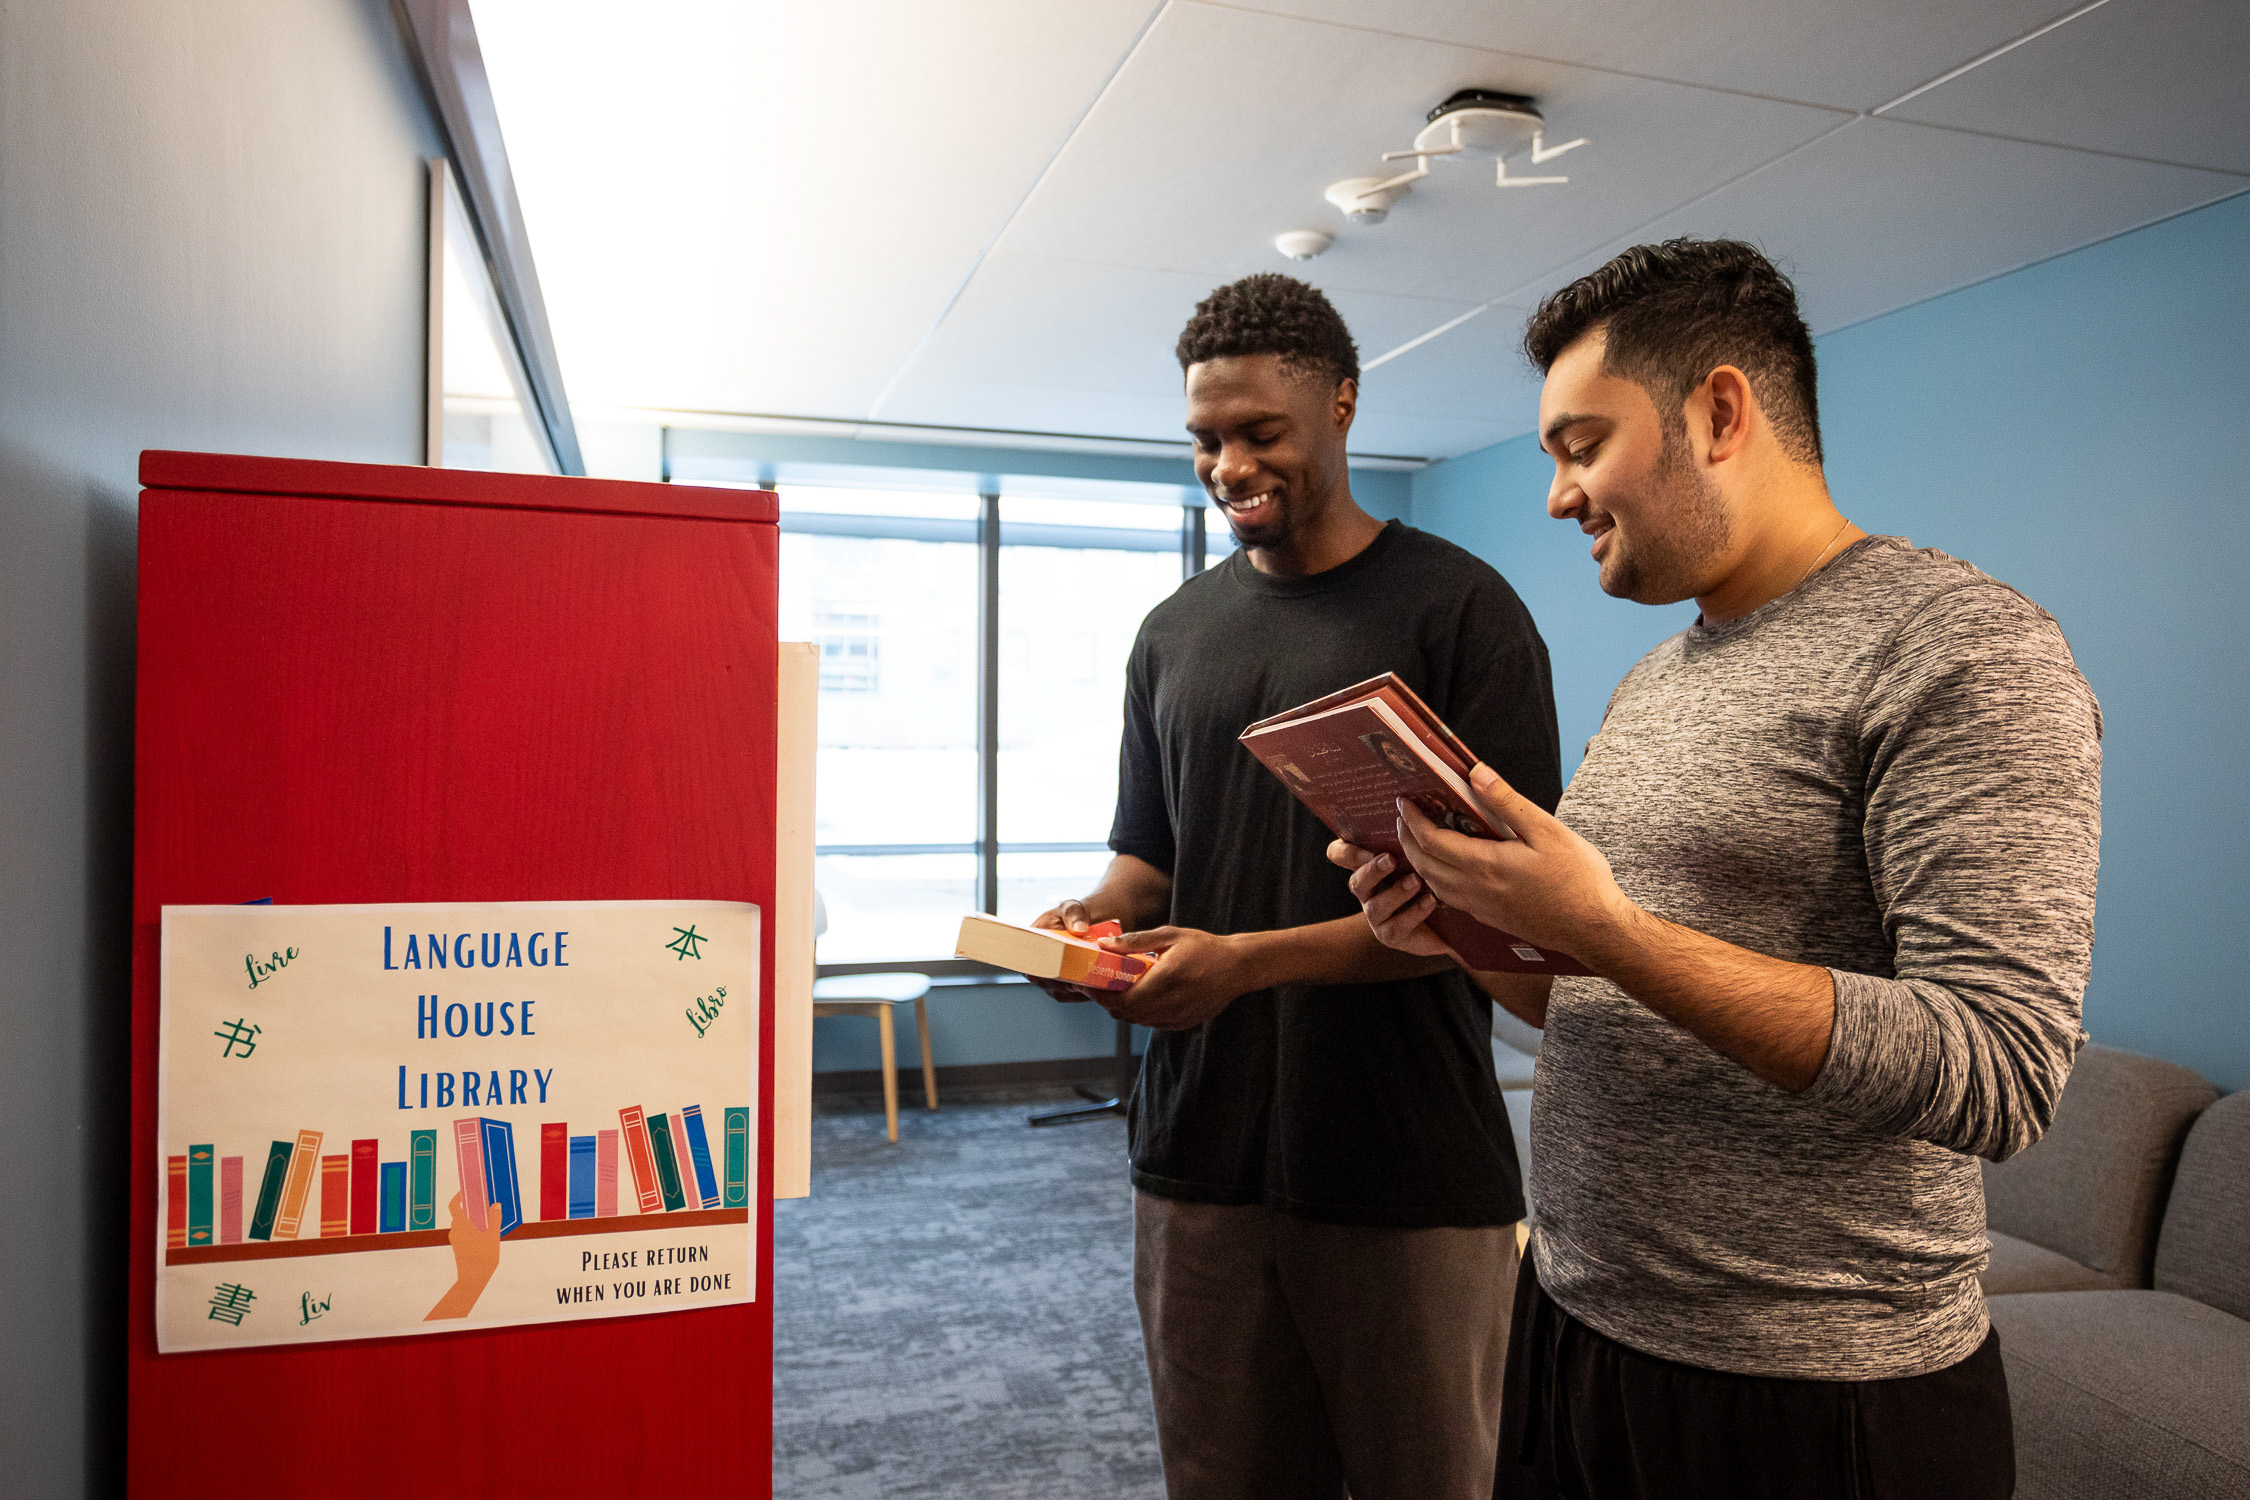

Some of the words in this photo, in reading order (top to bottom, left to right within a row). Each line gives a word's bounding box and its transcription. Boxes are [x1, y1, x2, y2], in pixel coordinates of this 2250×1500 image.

[384, 926, 569, 971] LANGUAGE
[666, 925, 709, 961] 本
[246, 945, 300, 990] Livre
[418, 995, 536, 1040] HOUSE
[685, 985, 728, 1039] Libro
[214, 1018, 263, 1059] 书
[399, 1066, 553, 1109] LIBRARY
[582, 1251, 638, 1272] PLEASE
[646, 1245, 709, 1267] RETURN
[208, 1283, 257, 1327] 書
[299, 1291, 333, 1327] Liv
[556, 1284, 604, 1305] WHEN
[612, 1280, 646, 1300] YOU
[653, 1277, 682, 1297] ARE
[690, 1273, 732, 1293] DONE
